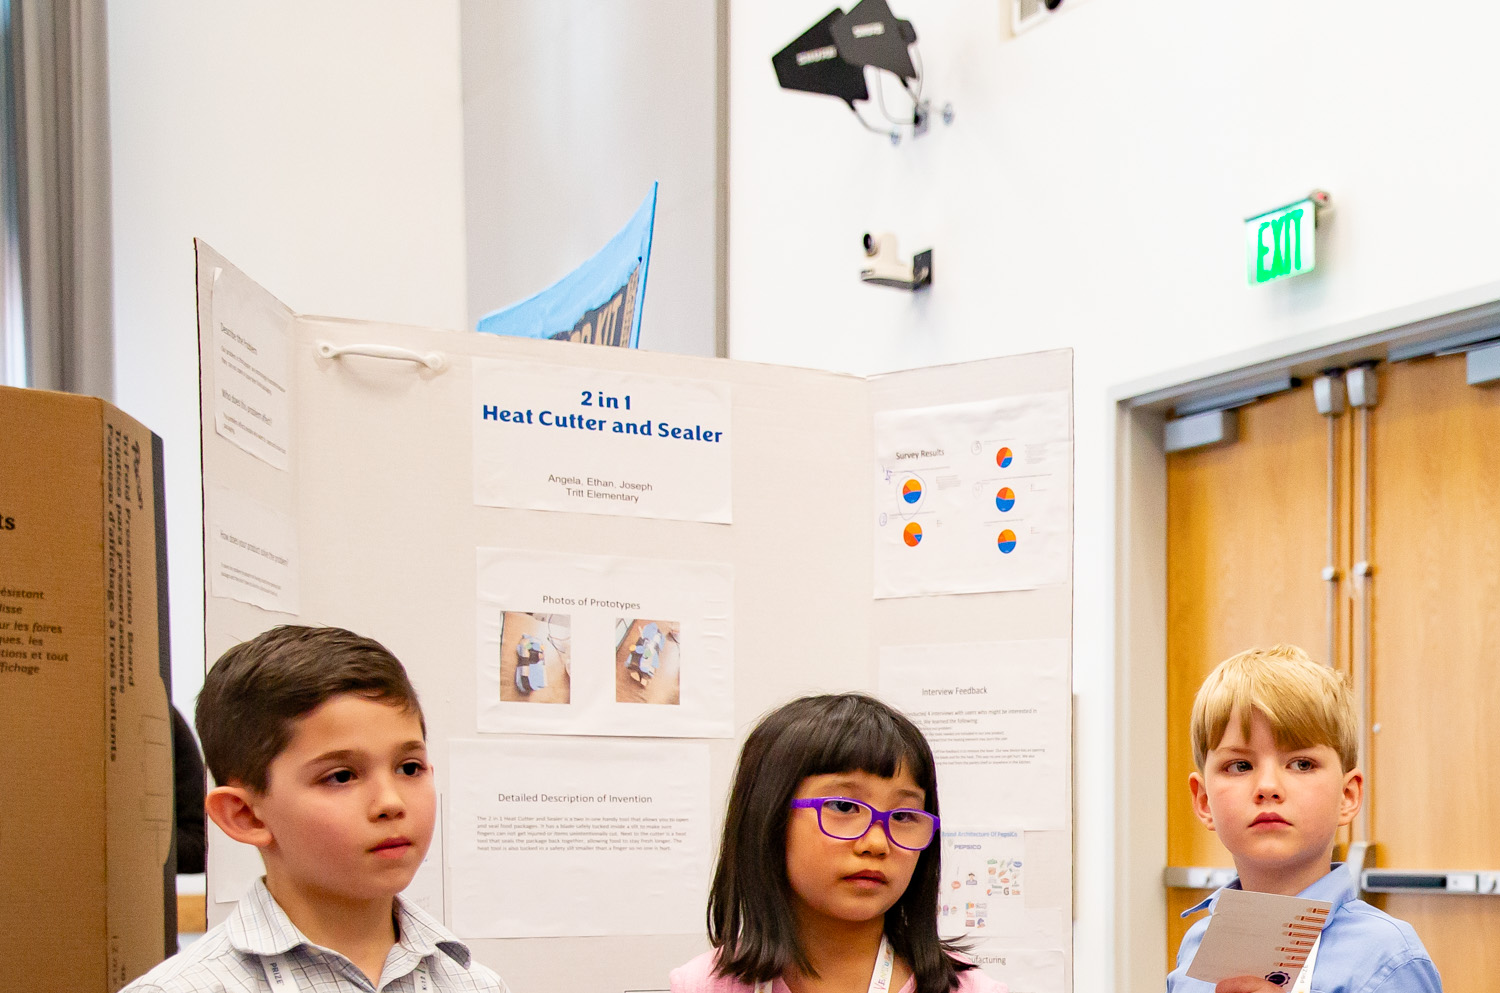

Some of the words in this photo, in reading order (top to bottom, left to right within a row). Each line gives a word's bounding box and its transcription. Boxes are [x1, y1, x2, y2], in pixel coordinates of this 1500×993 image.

[1256, 208, 1304, 283] EXIT
[581, 391, 593, 406] 2
[598, 391, 619, 410] in
[624, 395, 631, 410] 1
[483, 405, 533, 424] Heat
[538, 411, 607, 431] Cutter
[612, 420, 653, 436] and
[657, 423, 724, 443] Sealer
[107, 422, 115, 505] Panneau
[895, 451, 919, 461] Survey
[921, 448, 945, 458] Results
[566, 487, 585, 498] Tritt
[587, 489, 640, 503] Elementary
[619, 480, 653, 493] Joseph
[115, 503, 123, 546] para
[125, 507, 134, 625] Presentation
[542, 595, 576, 606] Photos
[578, 598, 588, 607] of
[590, 598, 641, 611] Prototypes
[14, 621, 29, 633] les
[32, 622, 63, 635] foires
[117, 552, 126, 694] presentaciones
[28, 636, 44, 647] les
[31, 651, 43, 661] et
[46, 652, 69, 663] tout
[110, 634, 118, 680] trois
[127, 631, 136, 688] Board
[922, 687, 955, 697] Interview
[955, 686, 988, 696] Feedback
[110, 686, 118, 762] battants
[498, 793, 539, 803] Detailed
[541, 793, 595, 804] Description
[597, 794, 607, 803] of
[609, 794, 653, 804] Invention
[269, 962, 284, 985] PRIZE
